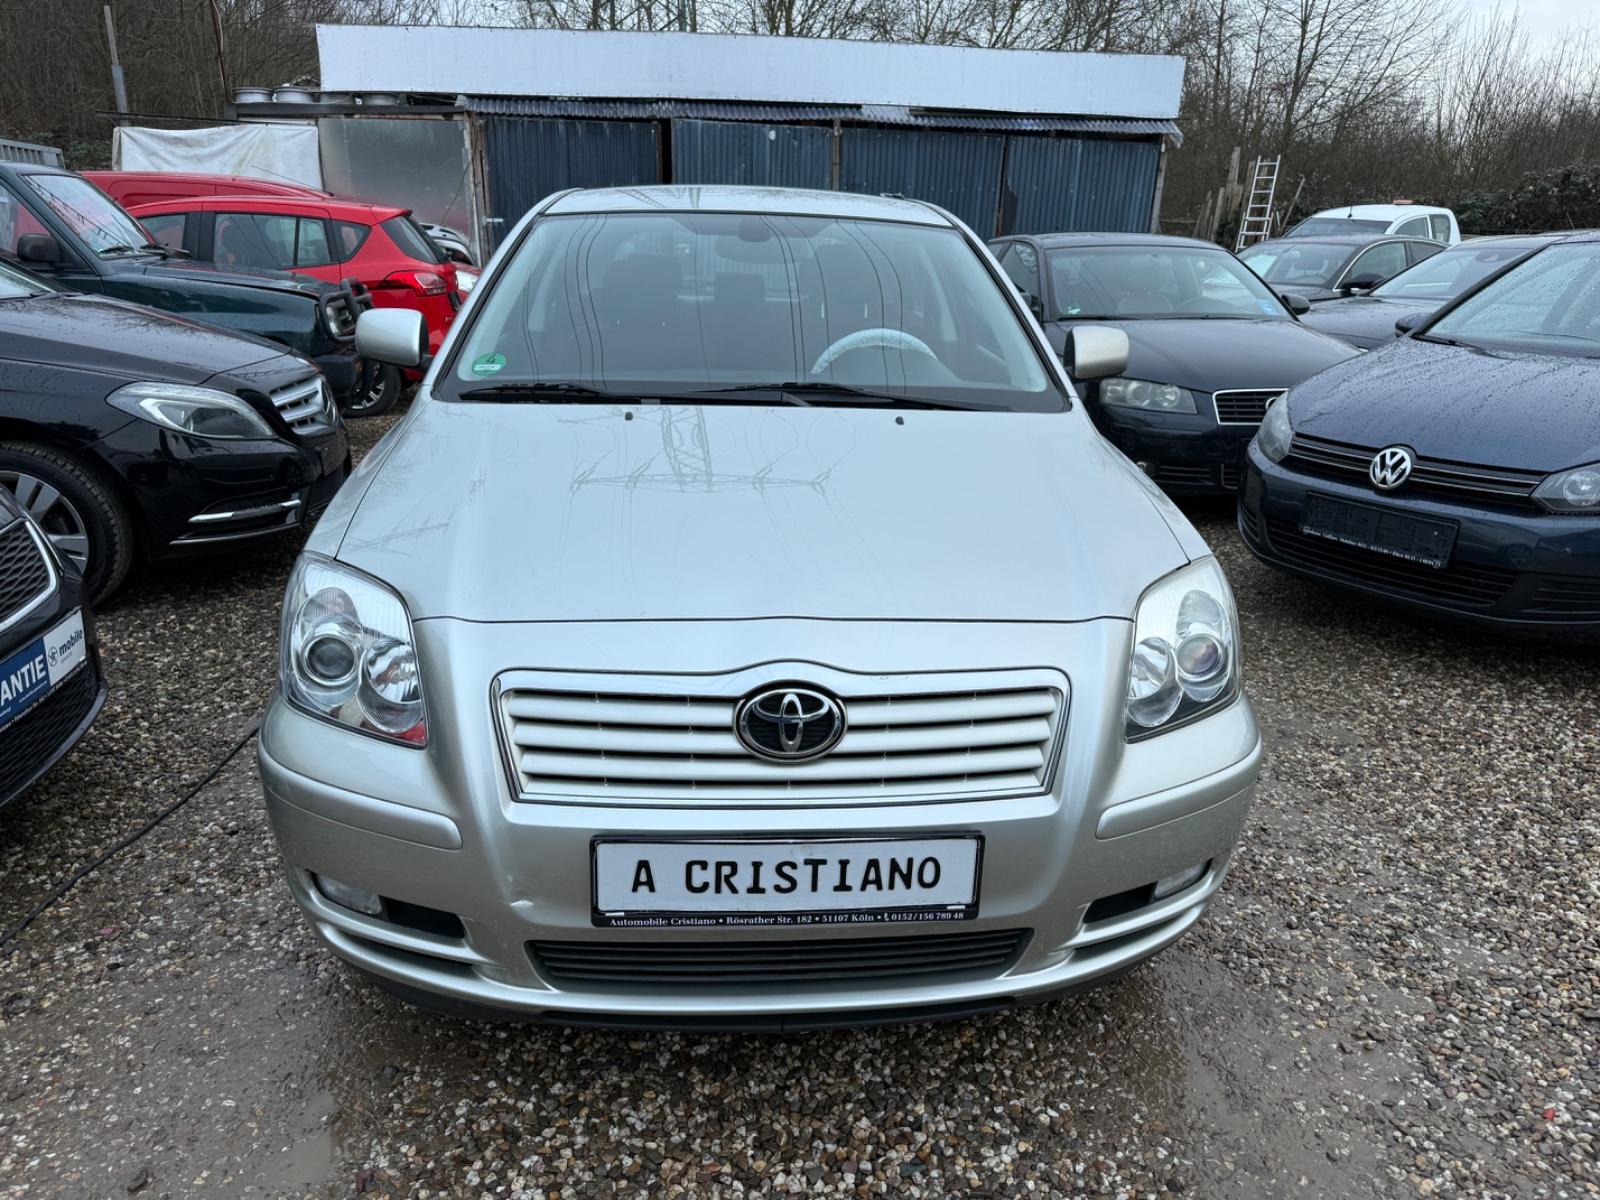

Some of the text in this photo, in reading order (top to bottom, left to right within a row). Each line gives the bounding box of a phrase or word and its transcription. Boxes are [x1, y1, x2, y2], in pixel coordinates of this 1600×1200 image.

[485, 353, 496, 364] 4
[59, 629, 83, 656] mobile
[631, 856, 942, 895] A CRISTIANO
[610, 917, 668, 927] Automobile
[670, 917, 716, 926] Cristiano
[726, 915, 775, 925] Rösrather
[777, 915, 793, 924] Str.
[797, 915, 812, 923] 182
[822, 914, 849, 923] 51107
[851, 912, 874, 922] Köln
[891, 912, 934, 921] 0152/156
[953, 912, 964, 920] 48
